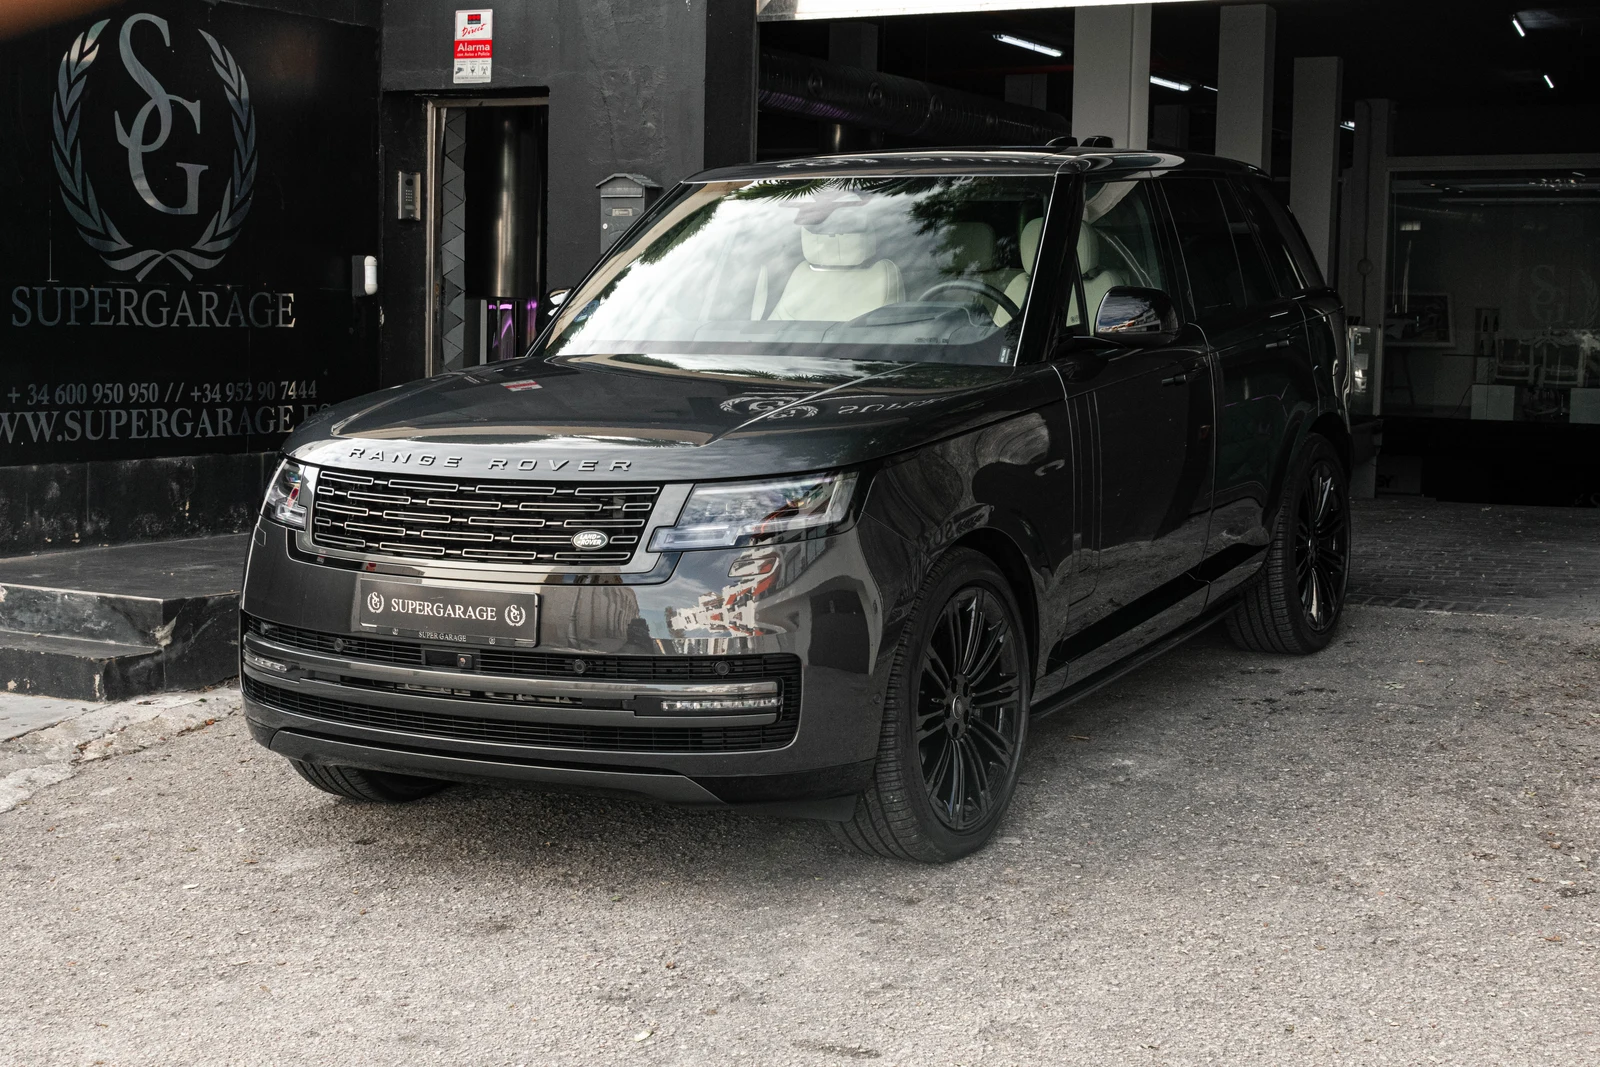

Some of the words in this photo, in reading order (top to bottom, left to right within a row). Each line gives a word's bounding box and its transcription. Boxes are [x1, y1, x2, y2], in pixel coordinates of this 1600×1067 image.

[457, 42, 490, 52] Alarma
[12, 285, 296, 328] SUPERGARAGE
[27, 383, 50, 405] 34
[55, 383, 87, 405] 600
[92, 383, 124, 405] 950
[128, 382, 159, 404] 950
[164, 382, 185, 403] //
[190, 382, 221, 403] +34
[226, 381, 253, 402] 952
[257, 381, 276, 401] 90
[280, 379, 317, 400] 7444
[348, 447, 462, 468] RANGE
[487, 458, 632, 472] ROVER
[391, 598, 497, 621] SUPERGARAGE
